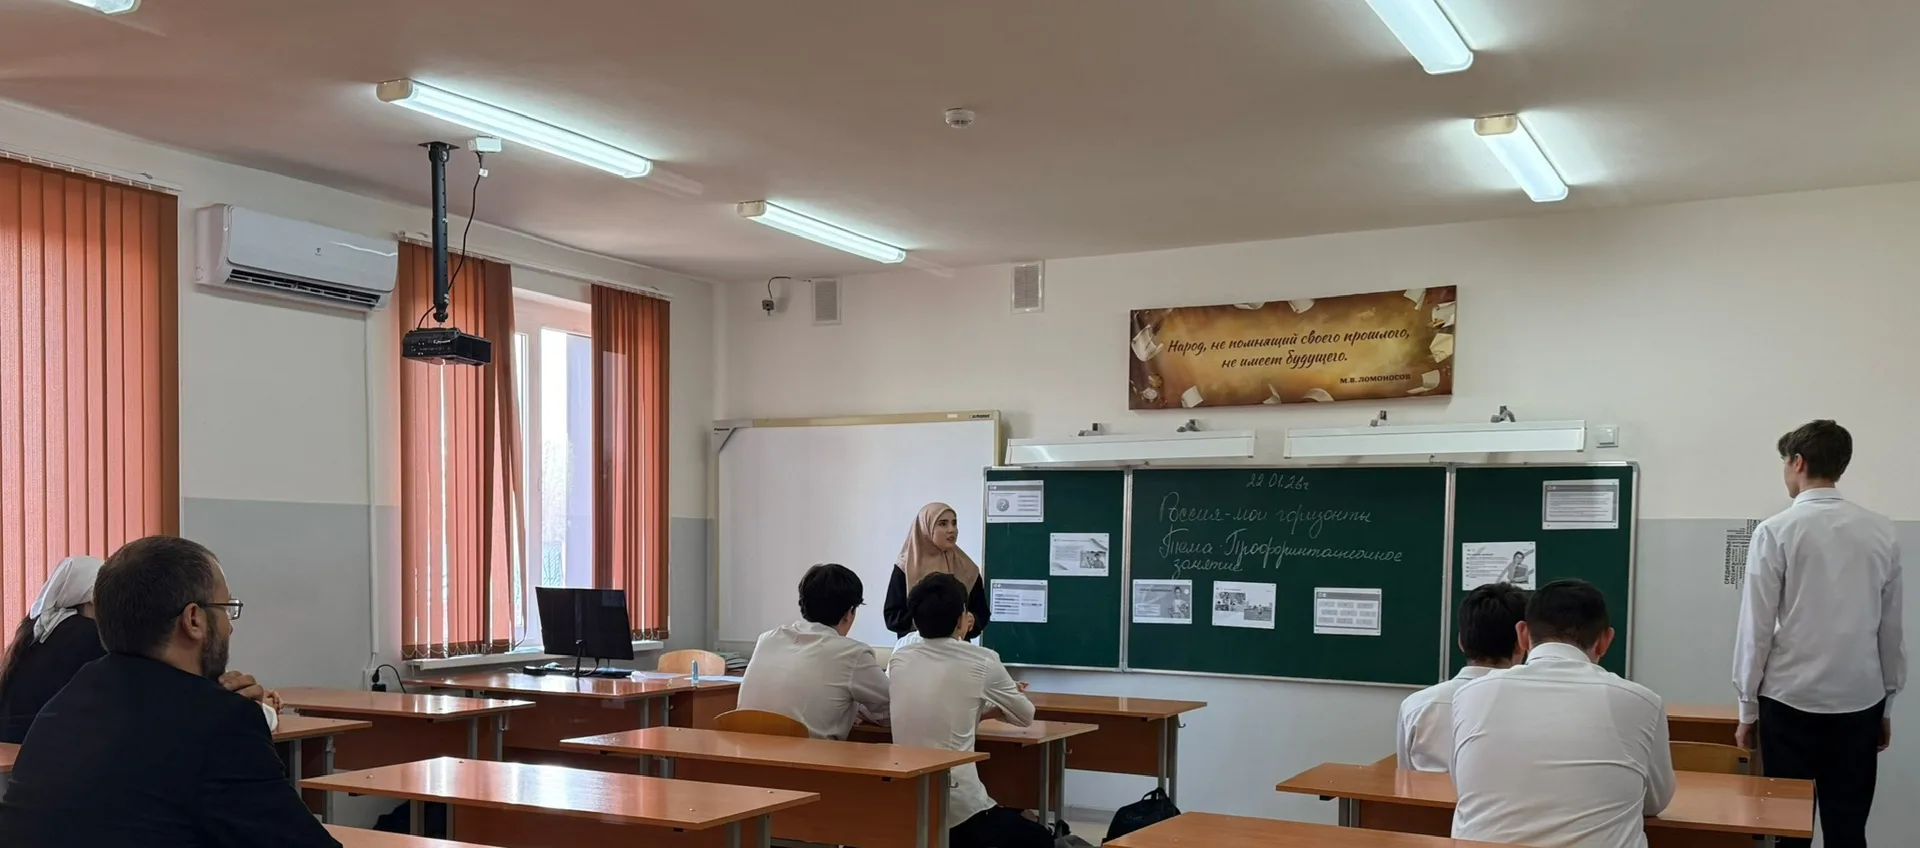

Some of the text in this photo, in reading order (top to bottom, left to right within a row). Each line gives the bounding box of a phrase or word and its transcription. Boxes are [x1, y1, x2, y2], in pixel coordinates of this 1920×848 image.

[1168, 328, 1410, 356] Народ, не помнящий своего прошлого,
[1221, 349, 1348, 369] не имеет будущего.
[1358, 373, 1411, 383] ЛОМОНОСОВ
[1275, 504, 1372, 539] горизонты
